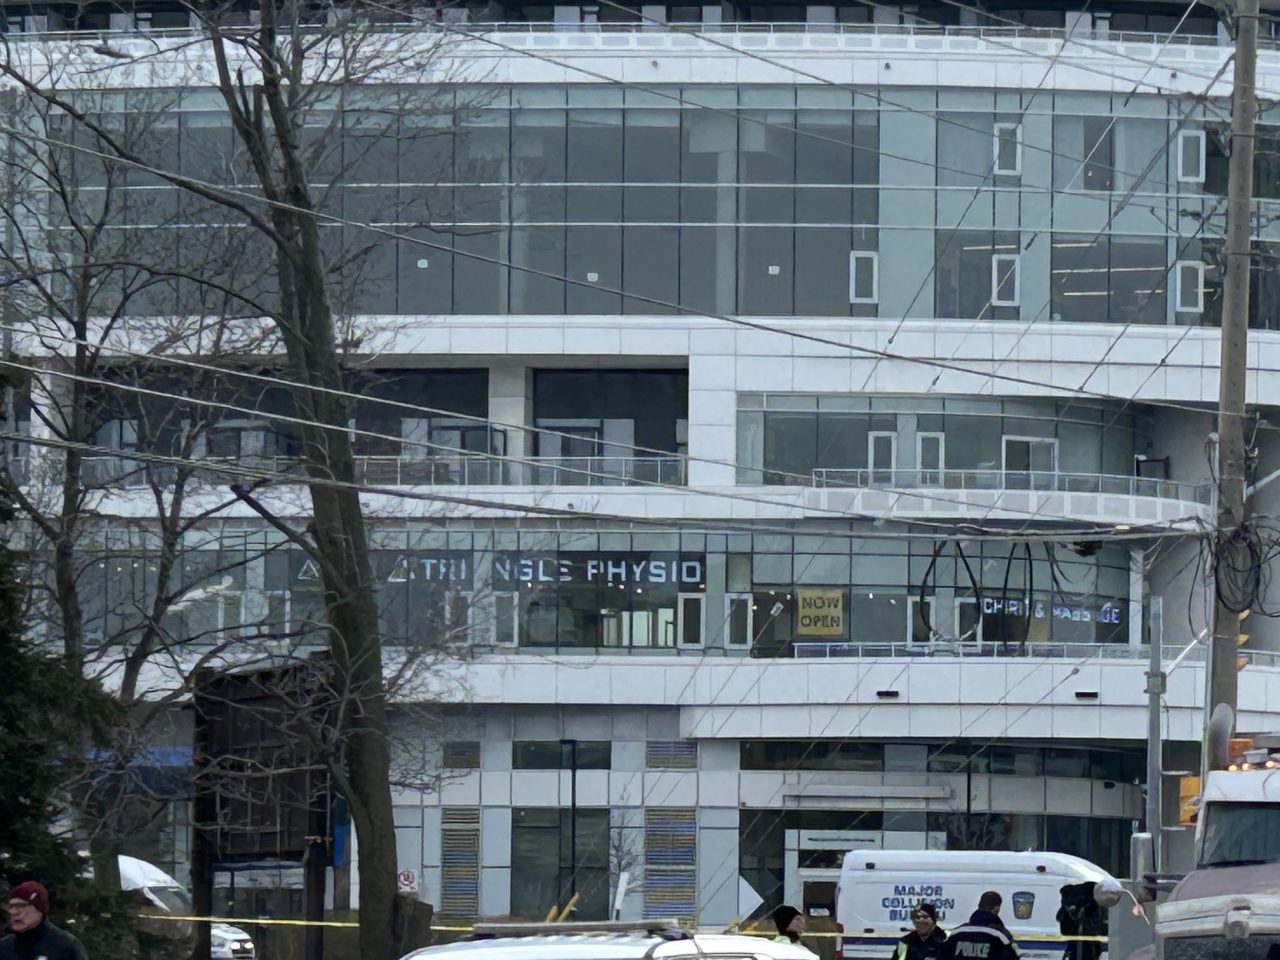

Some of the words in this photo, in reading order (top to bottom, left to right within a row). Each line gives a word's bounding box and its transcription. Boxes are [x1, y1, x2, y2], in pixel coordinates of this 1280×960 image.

[420, 558, 573, 582] TRINGLE
[587, 560, 701, 583] PHYSIO
[801, 597, 840, 609] NOW
[1052, 601, 1120, 623] MASSGE
[800, 615, 840, 628] OPEN
[893, 885, 943, 897] MAJOR
[881, 896, 955, 910] COLLION
[889, 909, 946, 922] BUU
[955, 941, 991, 959] POLICE
